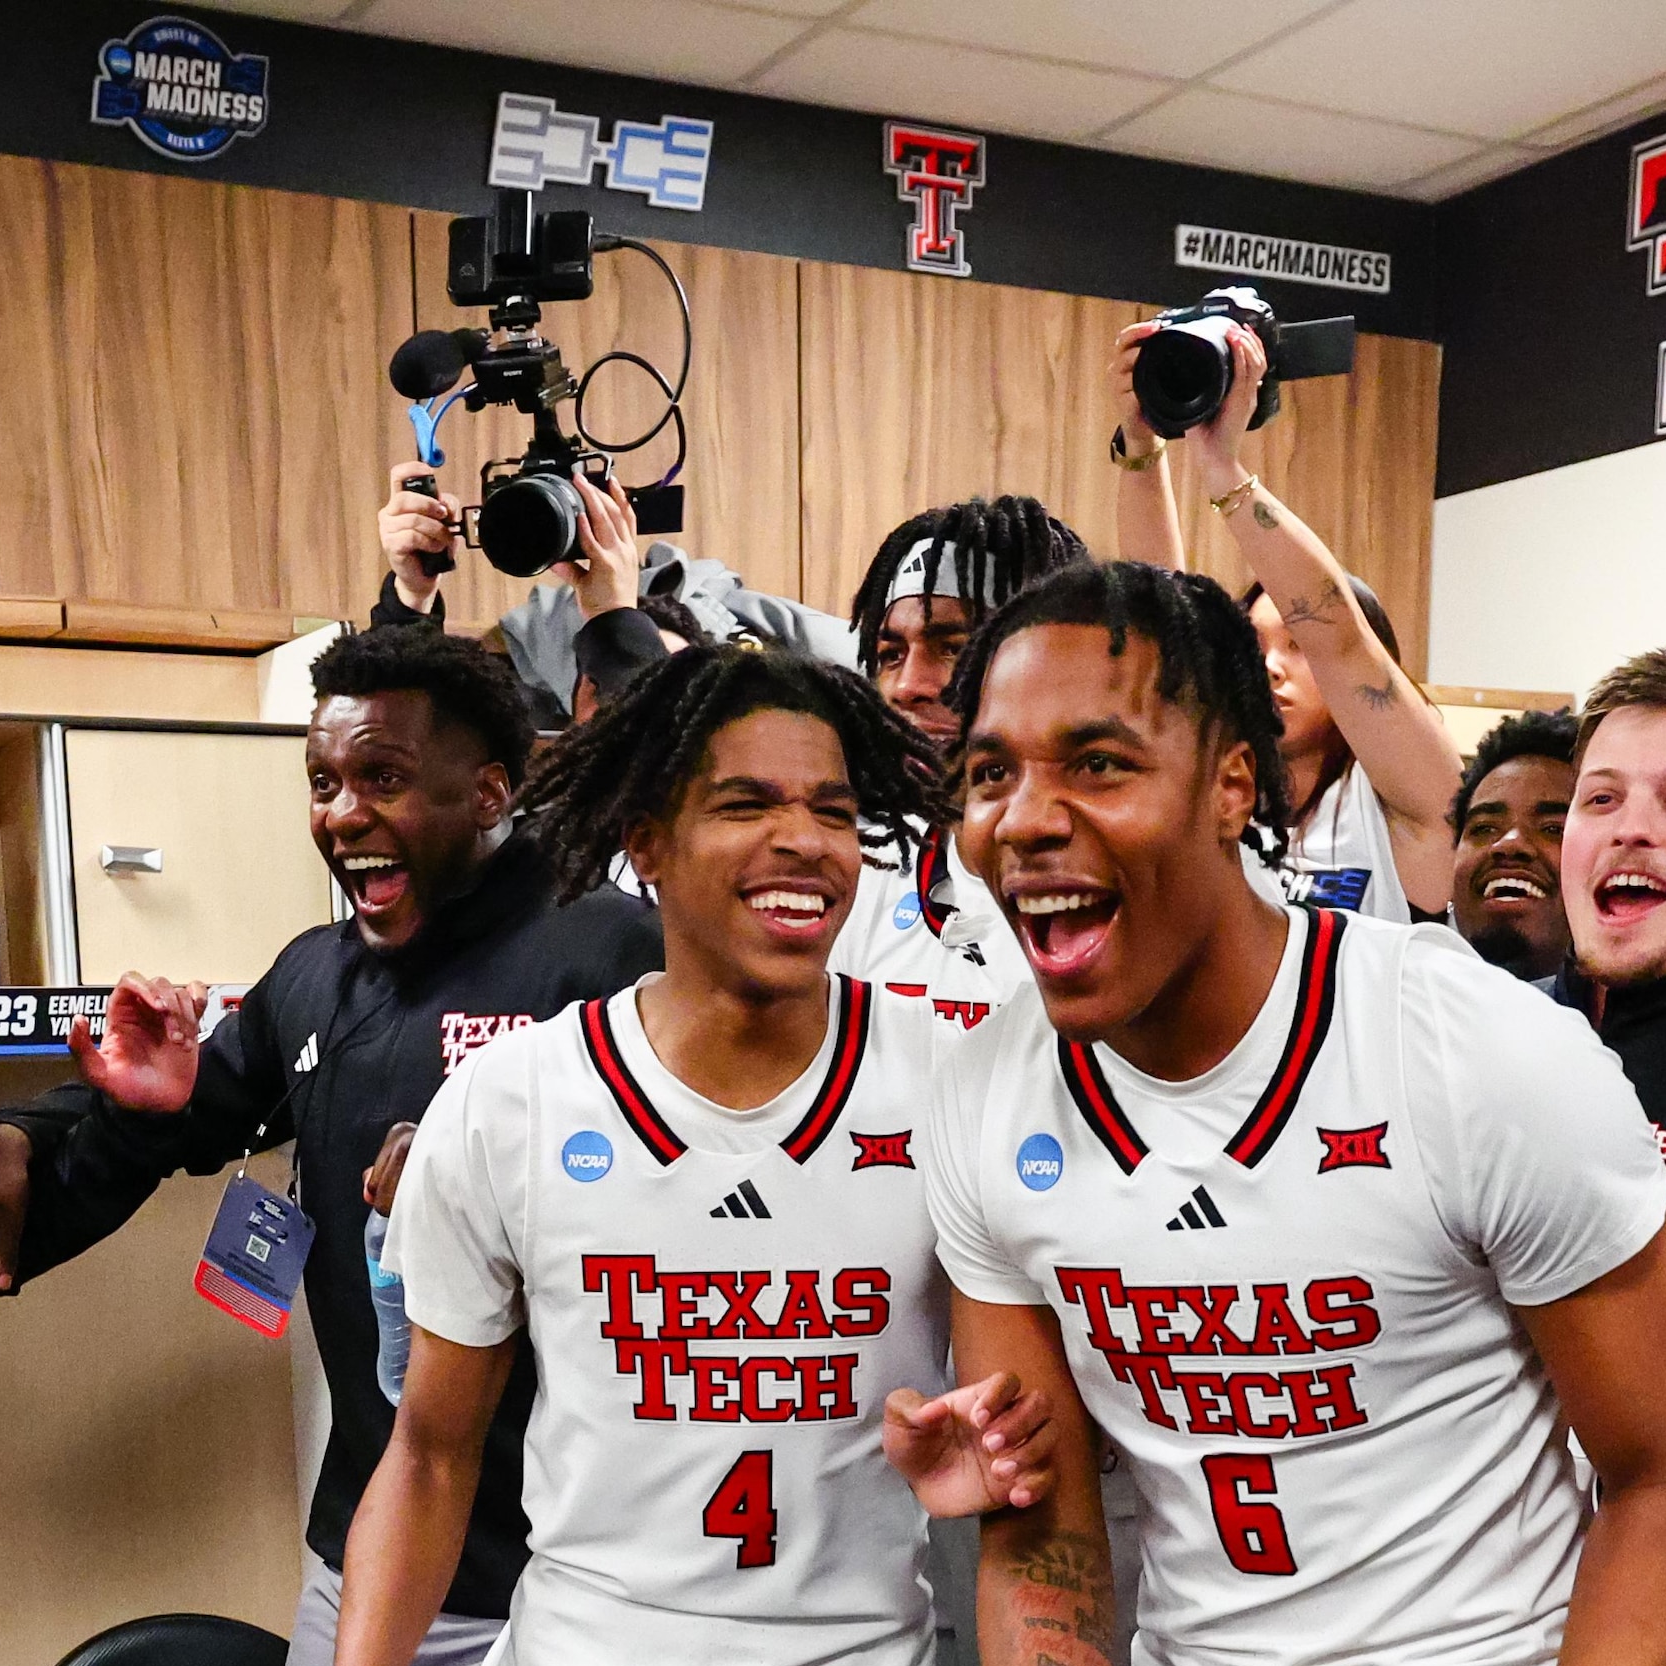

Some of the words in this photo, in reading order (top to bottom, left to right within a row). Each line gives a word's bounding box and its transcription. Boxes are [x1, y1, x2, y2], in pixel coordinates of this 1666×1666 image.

[134, 51, 222, 88] MARCH
[146, 82, 263, 122] MADNESS
[1185, 231, 1387, 287] #MARCHMADNESS
[567, 1153, 608, 1168] NCAA
[1021, 1158, 1060, 1179] NCAA
[581, 1254, 892, 1340] TEXAS
[1054, 1267, 1383, 1356] TEXAS
[616, 1338, 860, 1422] TECH
[1103, 1352, 1368, 1439] TECH
[703, 1450, 777, 1569] 4
[1200, 1451, 1298, 1576] 6
